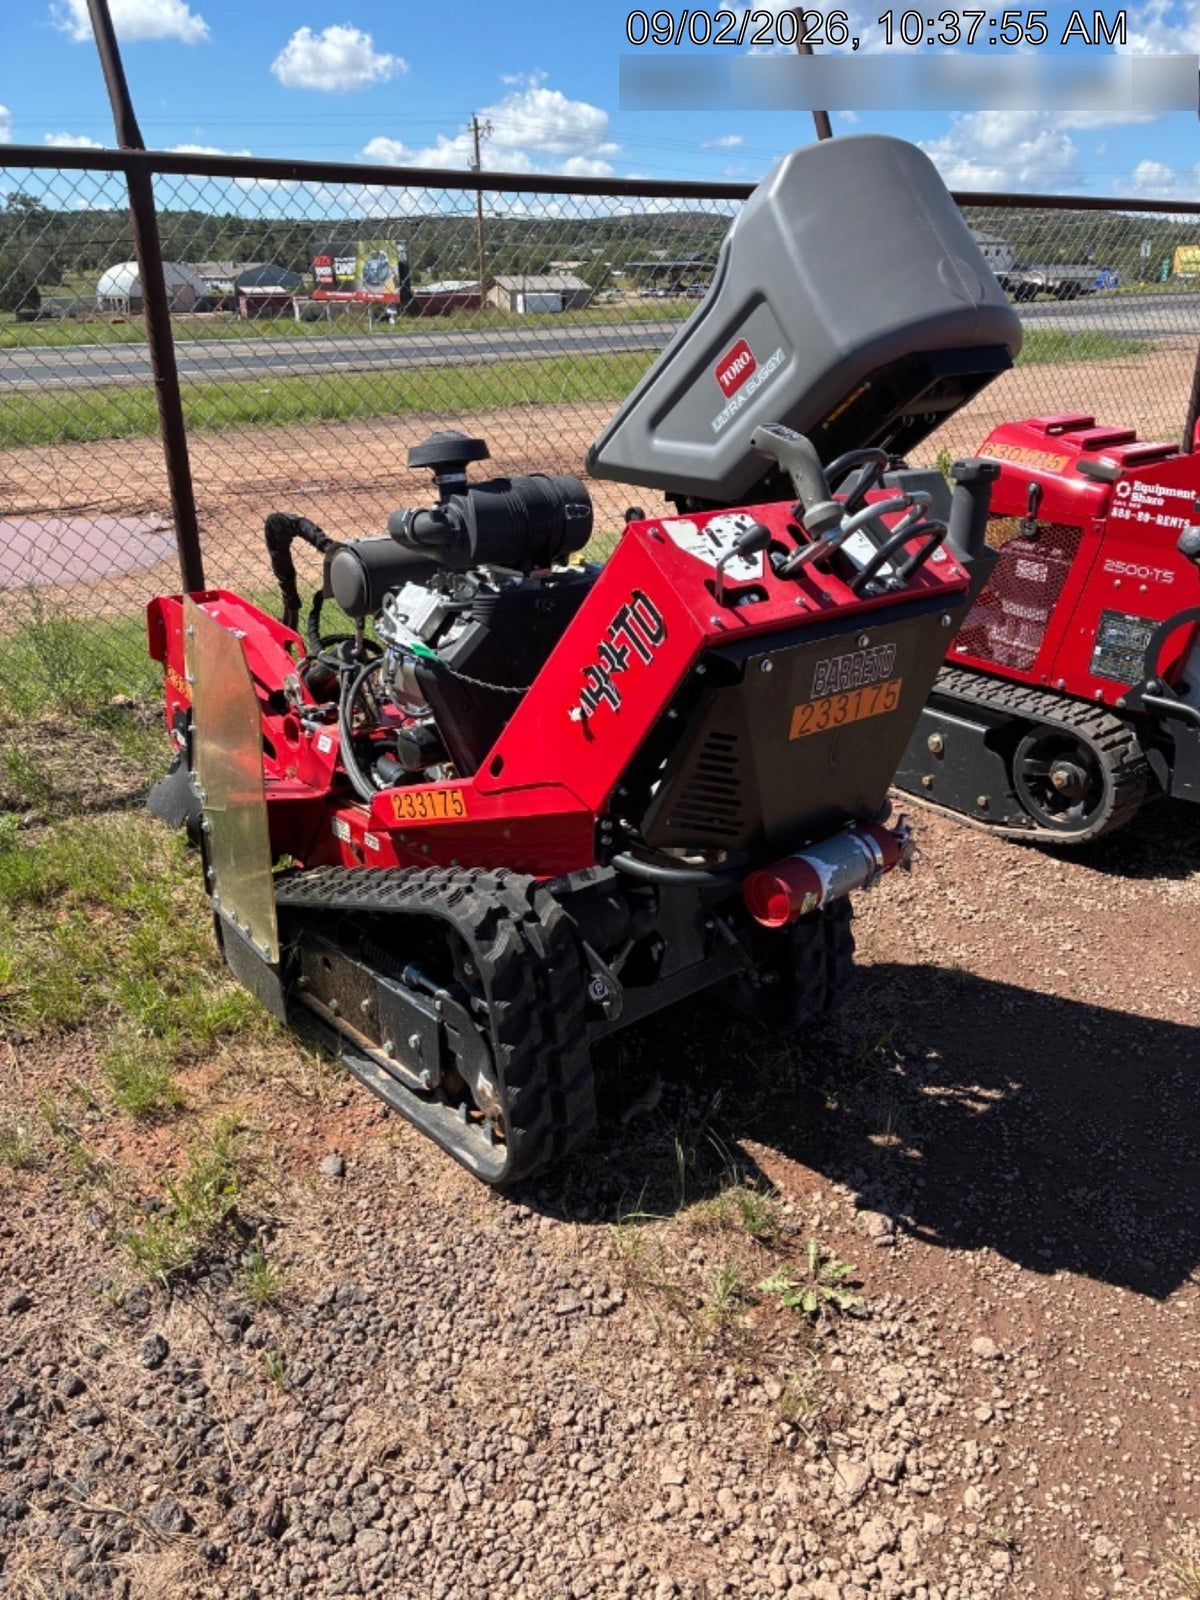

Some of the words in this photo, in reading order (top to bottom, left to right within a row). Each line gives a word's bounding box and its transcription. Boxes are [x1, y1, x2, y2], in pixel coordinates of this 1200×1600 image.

[720, 351, 751, 387] TORO
[711, 394, 747, 434] ULTRA
[745, 347, 786, 396] BUGGY
[1131, 492, 1165, 507] Share
[1133, 480, 1198, 500] Equipment
[810, 643, 897, 699] BARRETO
[798, 680, 899, 736] 233175
[392, 790, 464, 819] 233175
